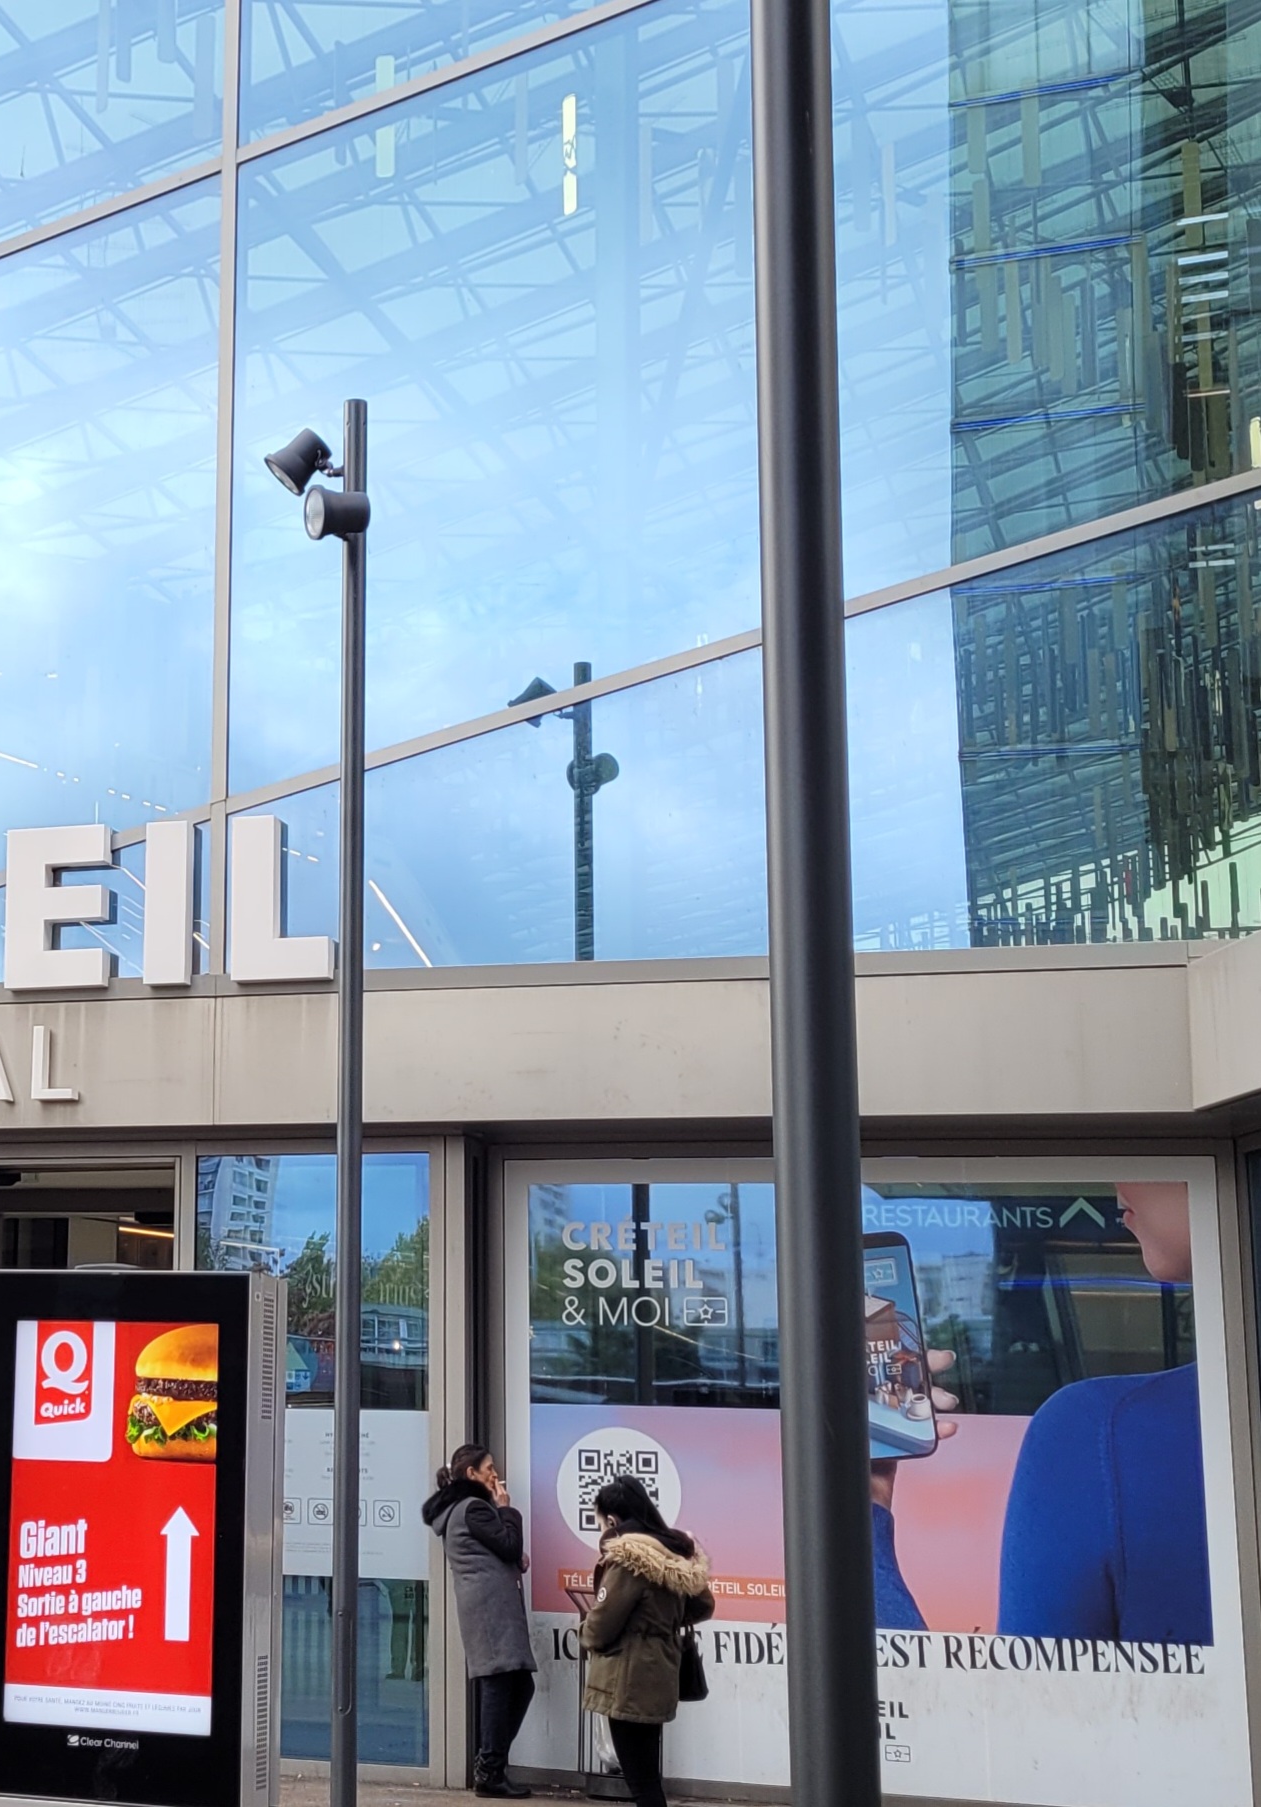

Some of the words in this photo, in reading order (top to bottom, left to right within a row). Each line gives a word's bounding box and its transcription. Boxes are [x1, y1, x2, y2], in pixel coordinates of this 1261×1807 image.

[561, 1213, 727, 1252] CRÉTEIL
[860, 1204, 1053, 1230] RESTAURANTS
[562, 1258, 704, 1290] SOLEIL
[561, 1296, 587, 1327] &
[598, 1296, 670, 1327] MOI
[40, 1397, 86, 1419] Quick
[19, 1518, 88, 1559] Giant
[17, 1563, 73, 1589] Niveau
[75, 1559, 87, 1583] 3
[16, 1591, 65, 1618] Sortie
[68, 1589, 79, 1614] à
[81, 1585, 142, 1616] gauche
[15, 1622, 36, 1648] de
[39, 1617, 125, 1646] l'escalator
[943, 1625, 1206, 1676] RÉCOMPENSÉE
[79, 1736, 103, 1748] Clear
[103, 1737, 139, 1750] Channel
